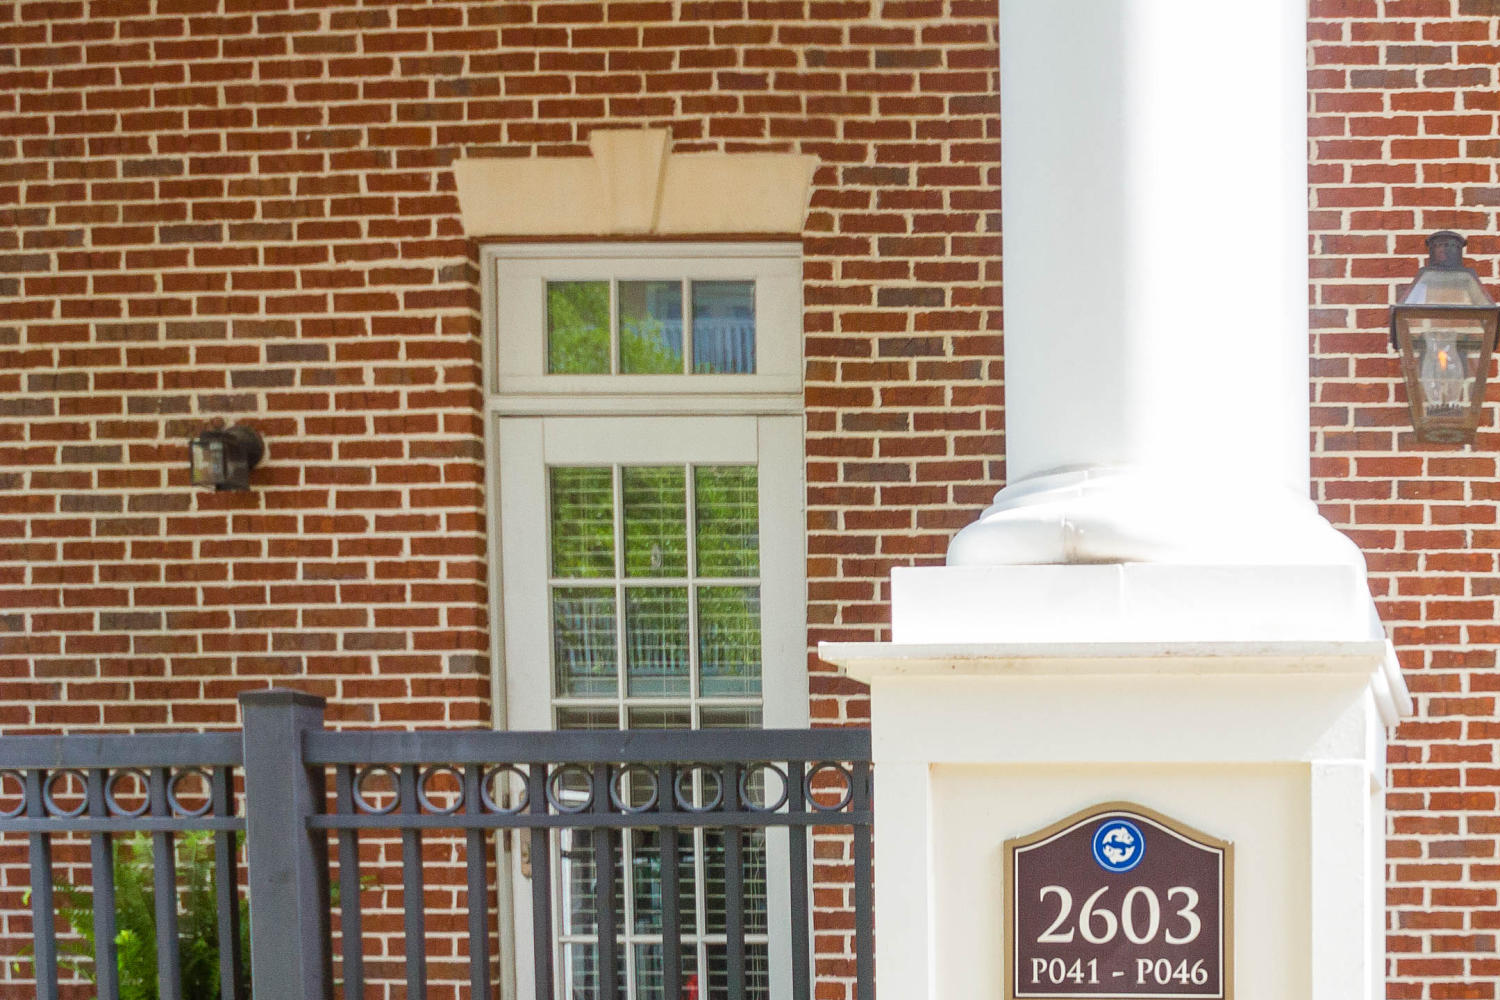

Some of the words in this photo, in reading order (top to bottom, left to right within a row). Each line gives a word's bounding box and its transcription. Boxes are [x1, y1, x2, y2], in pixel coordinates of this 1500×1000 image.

[1036, 885, 1202, 945] 2603
[1030, 957, 1100, 984] P041
[1136, 957, 1209, 985] P046
